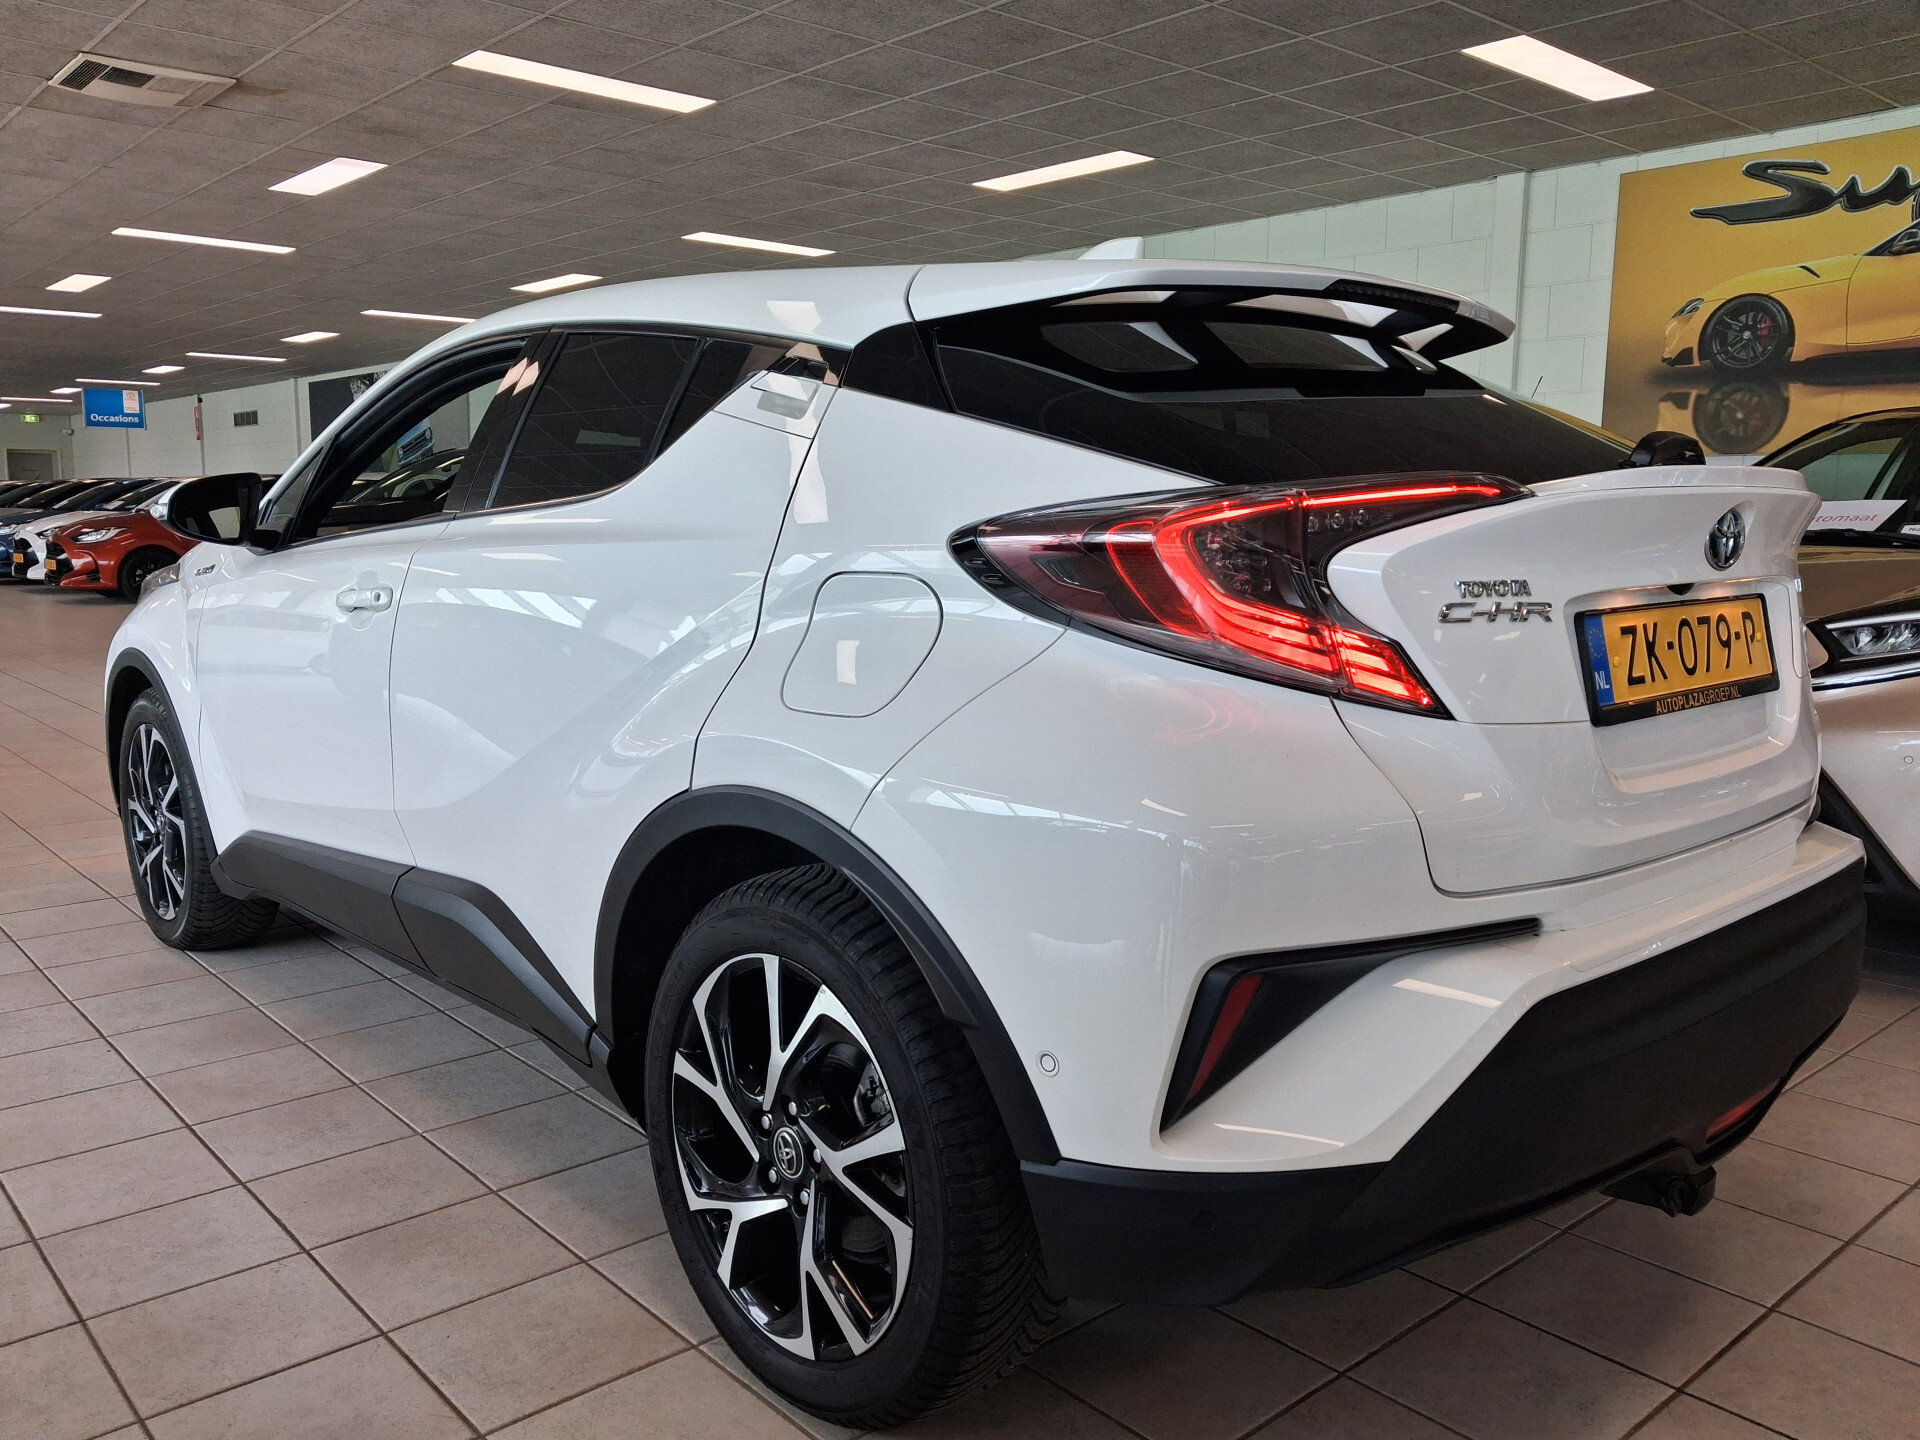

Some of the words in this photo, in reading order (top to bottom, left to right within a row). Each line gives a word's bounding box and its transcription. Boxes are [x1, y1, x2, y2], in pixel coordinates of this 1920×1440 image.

[90, 413, 139, 423] Occasions
[1455, 579, 1532, 598] TOYOTA
[1438, 602, 1553, 623] C-HR
[1620, 611, 1756, 686] ZK-079-P
[1594, 671, 1610, 690] NL
[1656, 685, 1741, 714] AUTOPLAZAGROEP.NL
